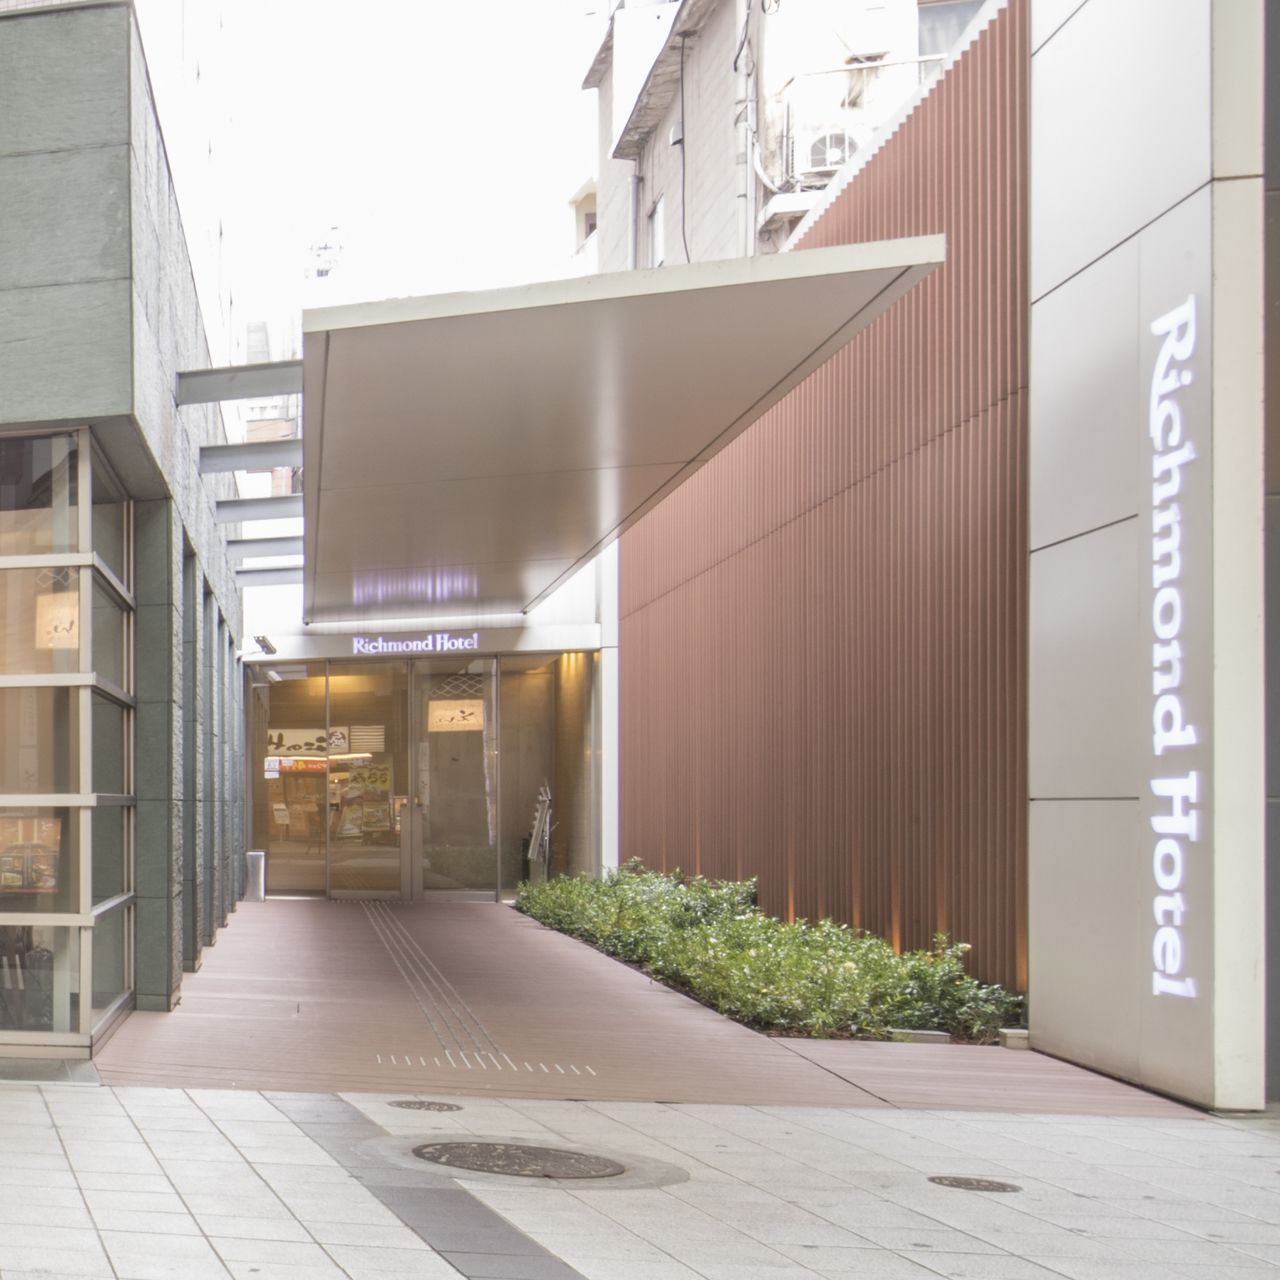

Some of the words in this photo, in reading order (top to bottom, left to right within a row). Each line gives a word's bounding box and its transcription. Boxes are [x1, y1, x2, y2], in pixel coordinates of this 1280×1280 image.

[1150, 293, 1197, 756] Richmond
[352, 634, 434, 655] Richmond
[436, 632, 479, 651] Hotel
[1150, 770, 1199, 998] Hotel
